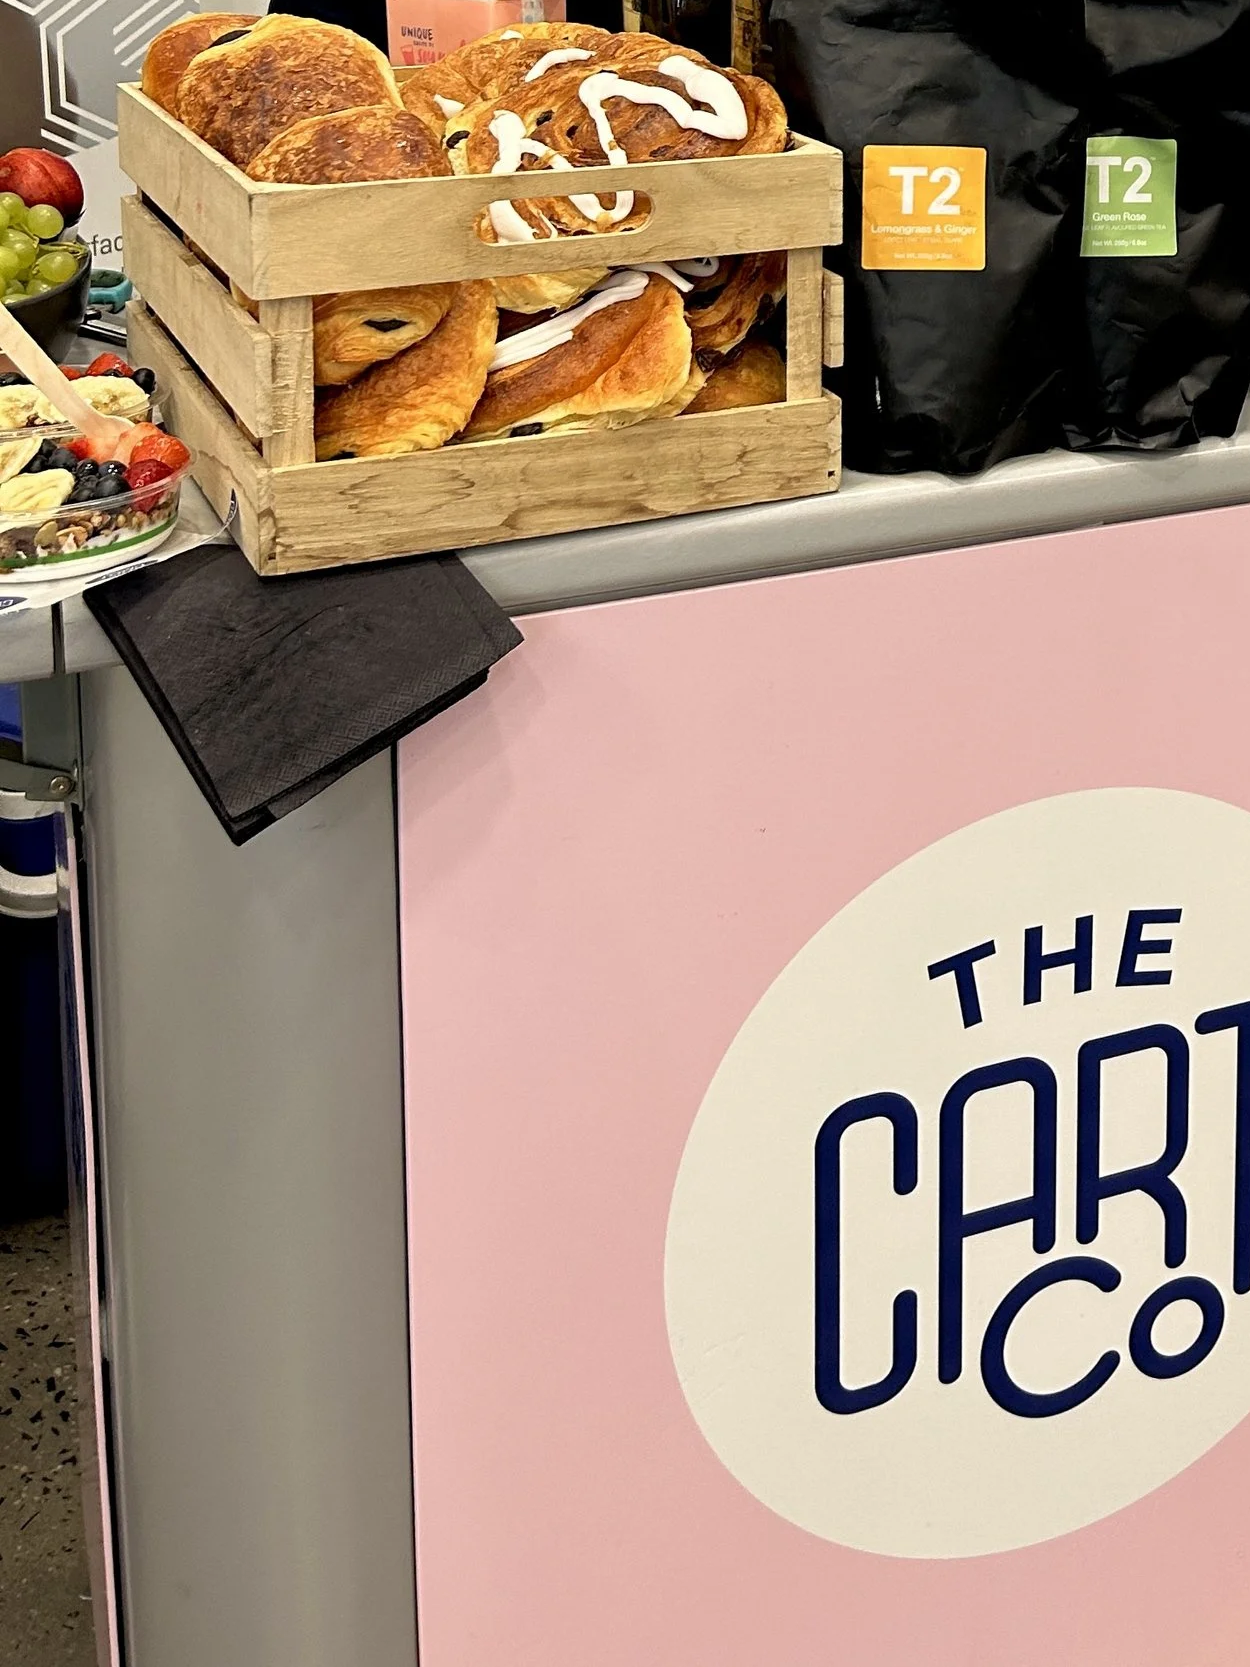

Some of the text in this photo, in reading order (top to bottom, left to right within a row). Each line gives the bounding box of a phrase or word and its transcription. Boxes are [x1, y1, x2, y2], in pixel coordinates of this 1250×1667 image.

[401, 25, 434, 41] UNIQUE
[888, 166, 961, 215] T2
[1087, 156, 1152, 203] T2
[1092, 211, 1147, 222] Green Rose
[927, 908, 1183, 1029] THE
[980, 1255, 1226, 1419] Co
